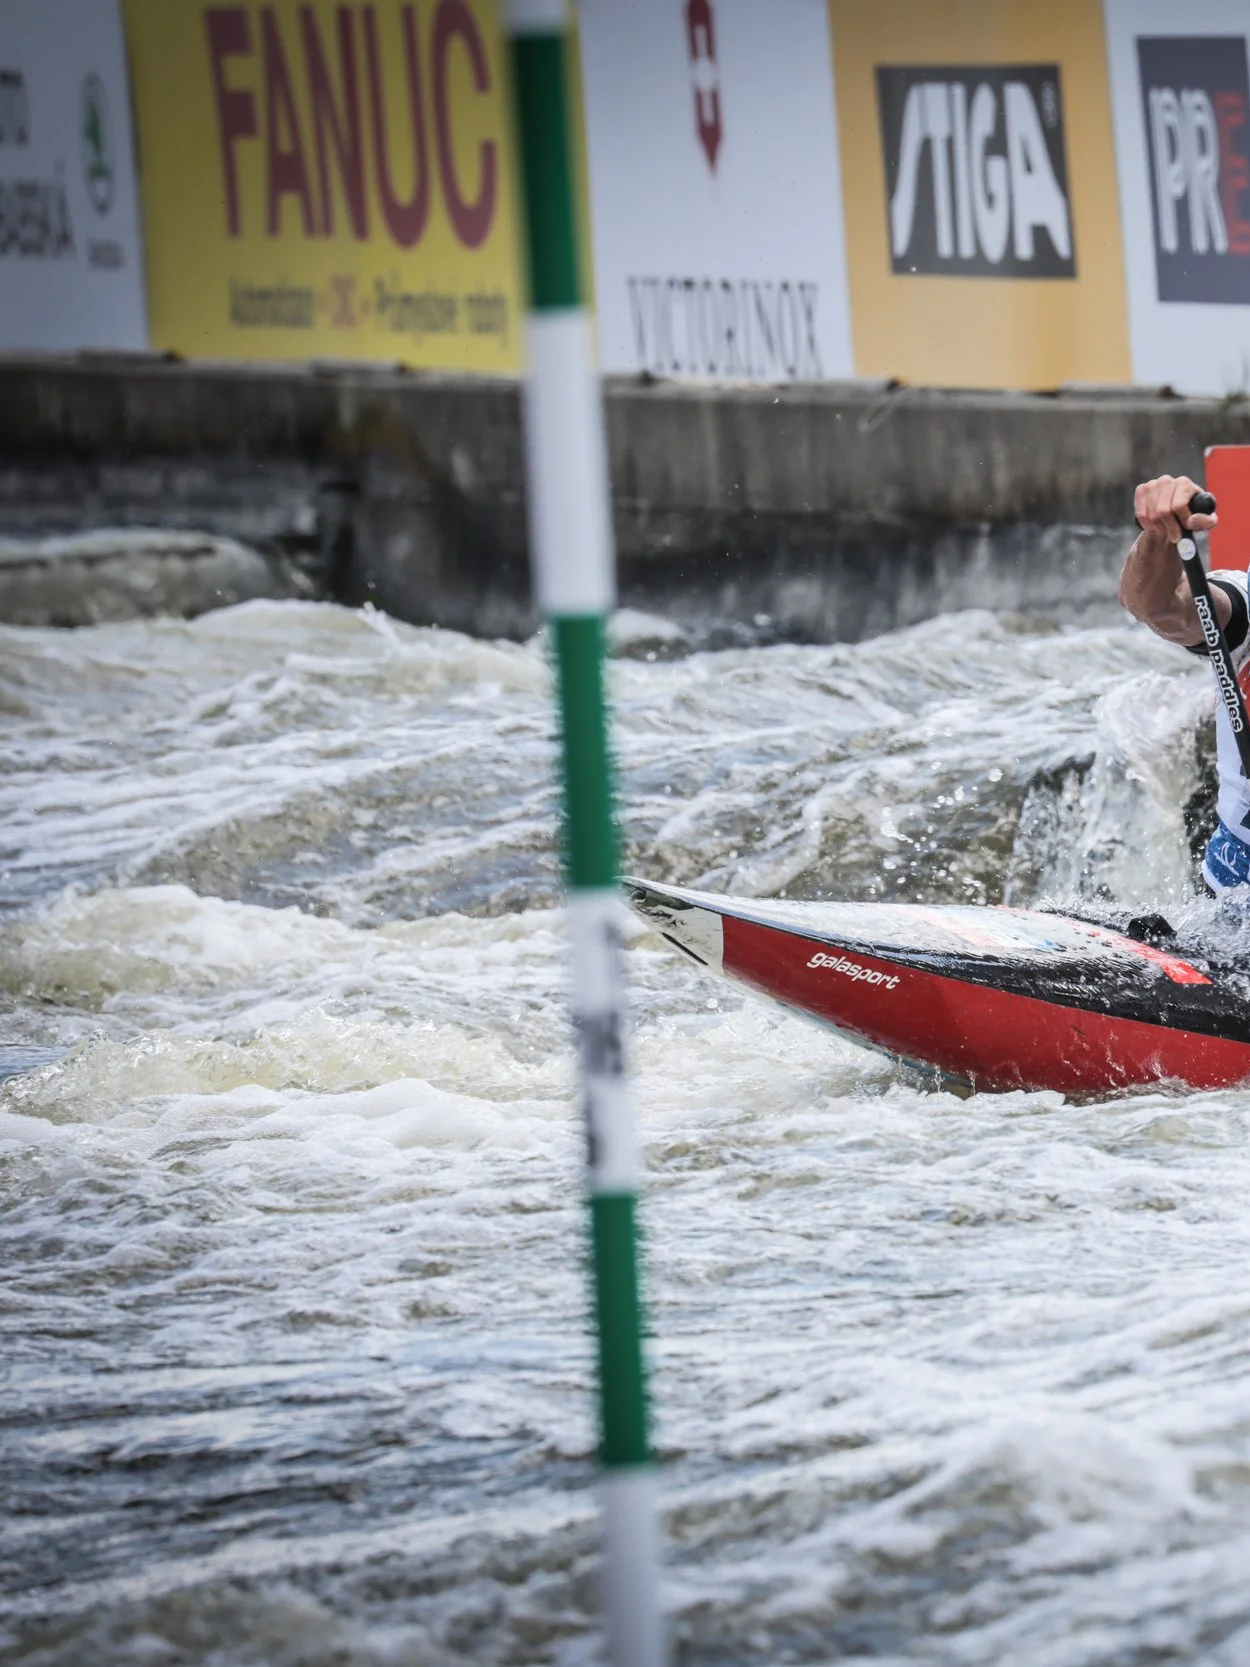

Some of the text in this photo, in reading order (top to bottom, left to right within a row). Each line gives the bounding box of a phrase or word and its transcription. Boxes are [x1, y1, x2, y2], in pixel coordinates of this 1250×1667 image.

[204, 0, 497, 251] FANUC
[892, 82, 1072, 264] STIGA
[626, 277, 824, 378] VICTORINOX
[1194, 595, 1244, 733] raab paddles
[806, 952, 901, 989] galasport
